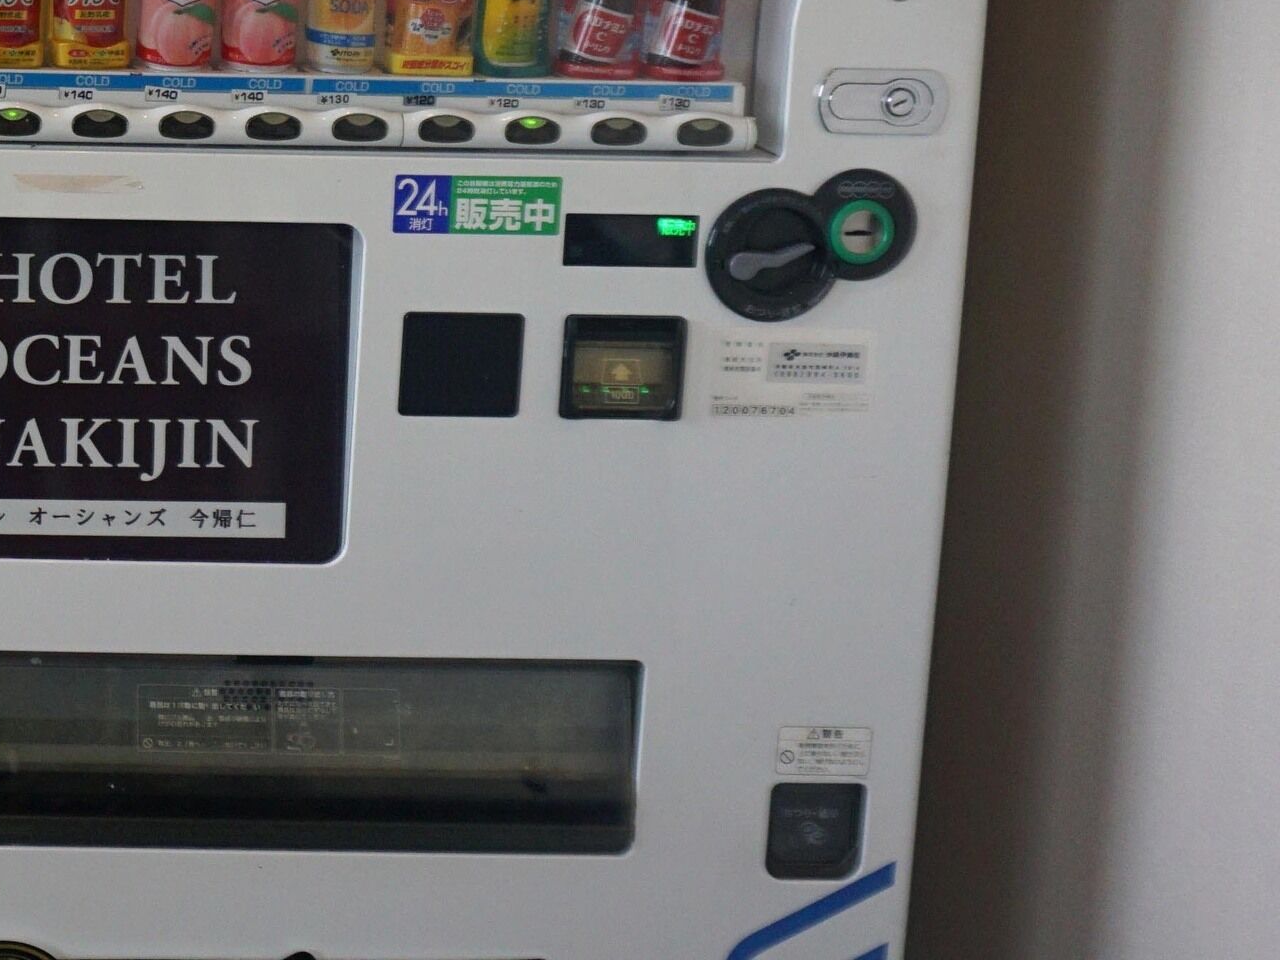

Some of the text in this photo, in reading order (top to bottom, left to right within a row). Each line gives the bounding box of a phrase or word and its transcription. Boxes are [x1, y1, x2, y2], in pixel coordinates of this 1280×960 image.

[75, 75, 110, 87] COLD
[162, 77, 196, 88] COLD
[248, 78, 282, 90] COLD
[335, 80, 369, 92] COLD
[148, 88, 179, 100] ¥140
[421, 82, 456, 94] COLD
[506, 83, 540, 95] COLD
[592, 84, 626, 96] COLD
[678, 86, 712, 97] COLD
[64, 89, 93, 101] ¥140
[234, 90, 264, 102] ¥140
[320, 94, 350, 105] ¥130
[396, 177, 449, 217] 24h
[454, 198, 556, 232] 販売中
[409, 217, 435, 232] 消灯
[28, 507, 167, 529] オーシャンズ
[189, 509, 258, 530] 今帰仁
